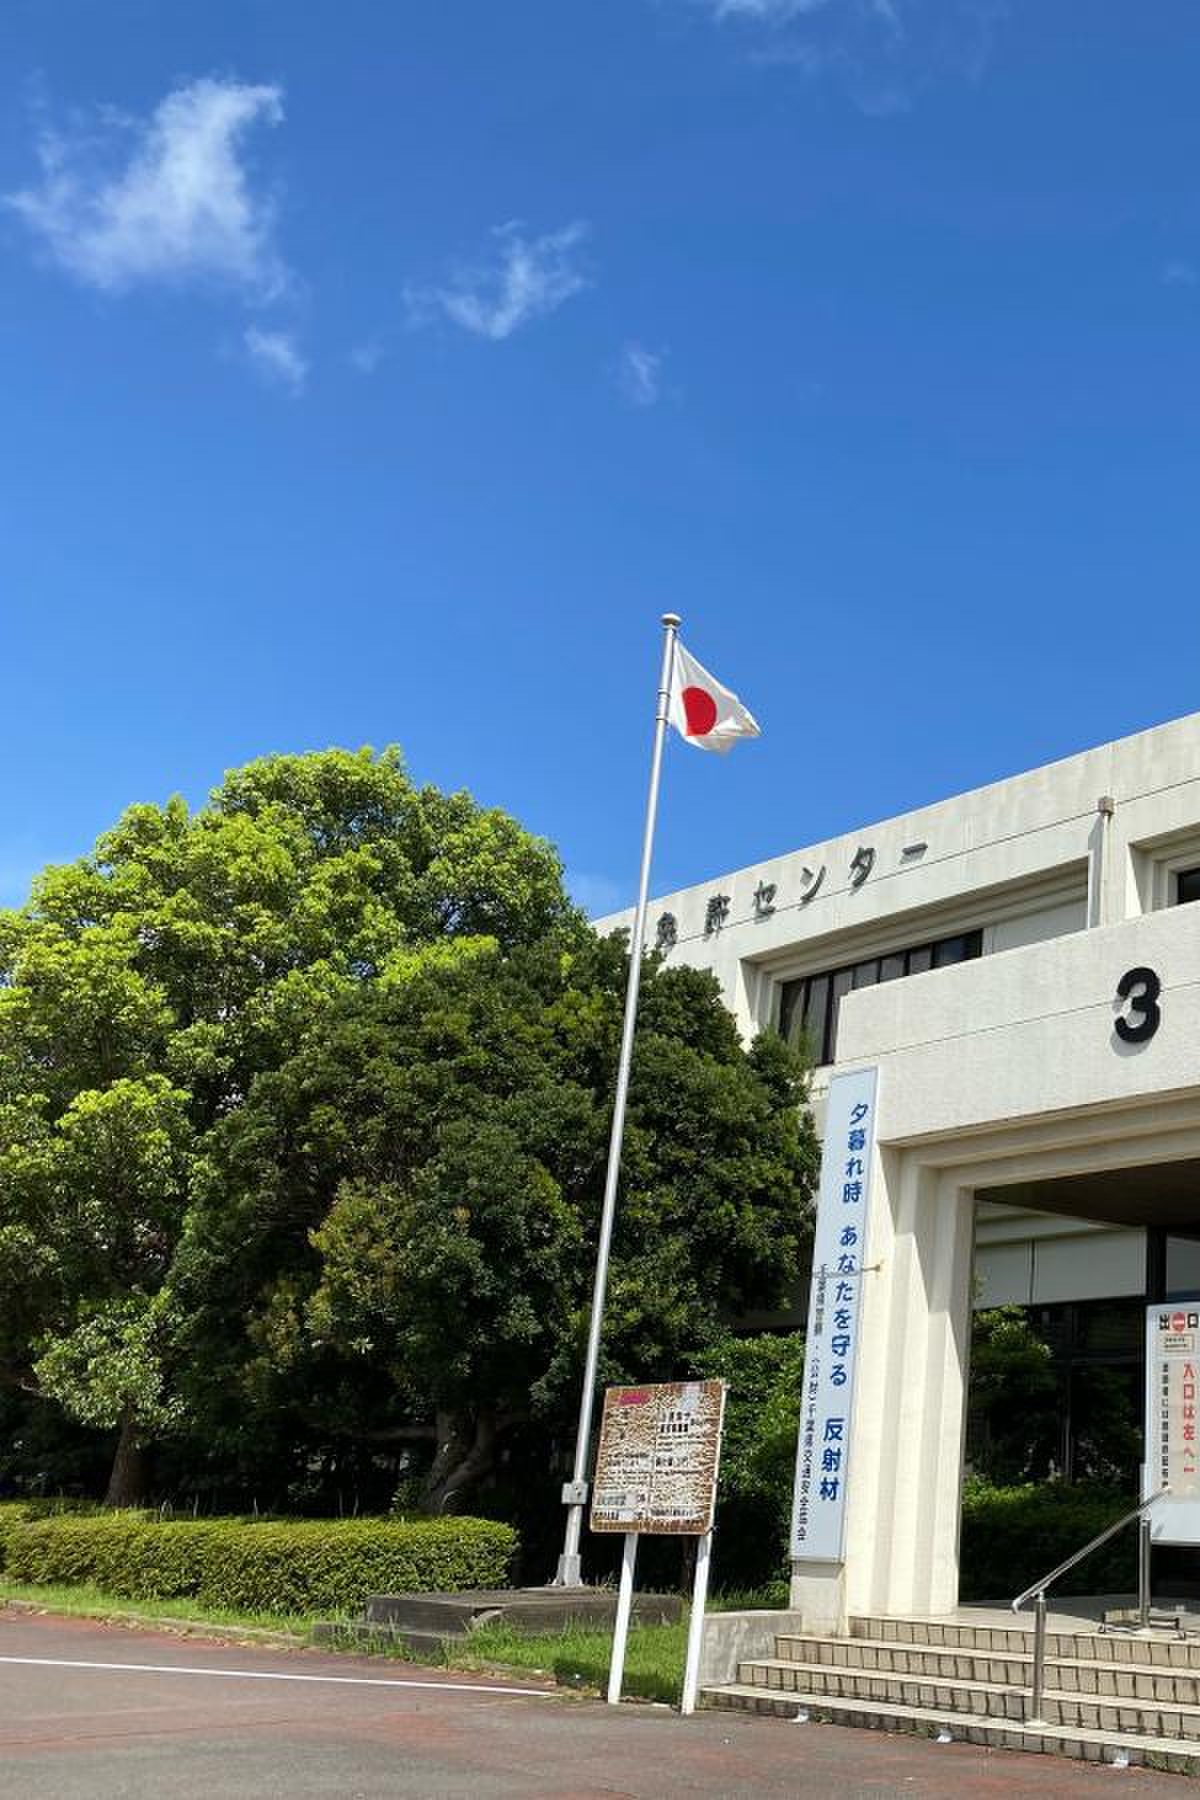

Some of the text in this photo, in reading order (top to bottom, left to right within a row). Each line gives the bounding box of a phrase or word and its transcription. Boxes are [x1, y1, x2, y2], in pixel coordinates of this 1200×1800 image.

[1115, 966, 1161, 1043] 3
[820, 1103, 868, 1501] 夕暮れ時 あなたを守る 反射材
